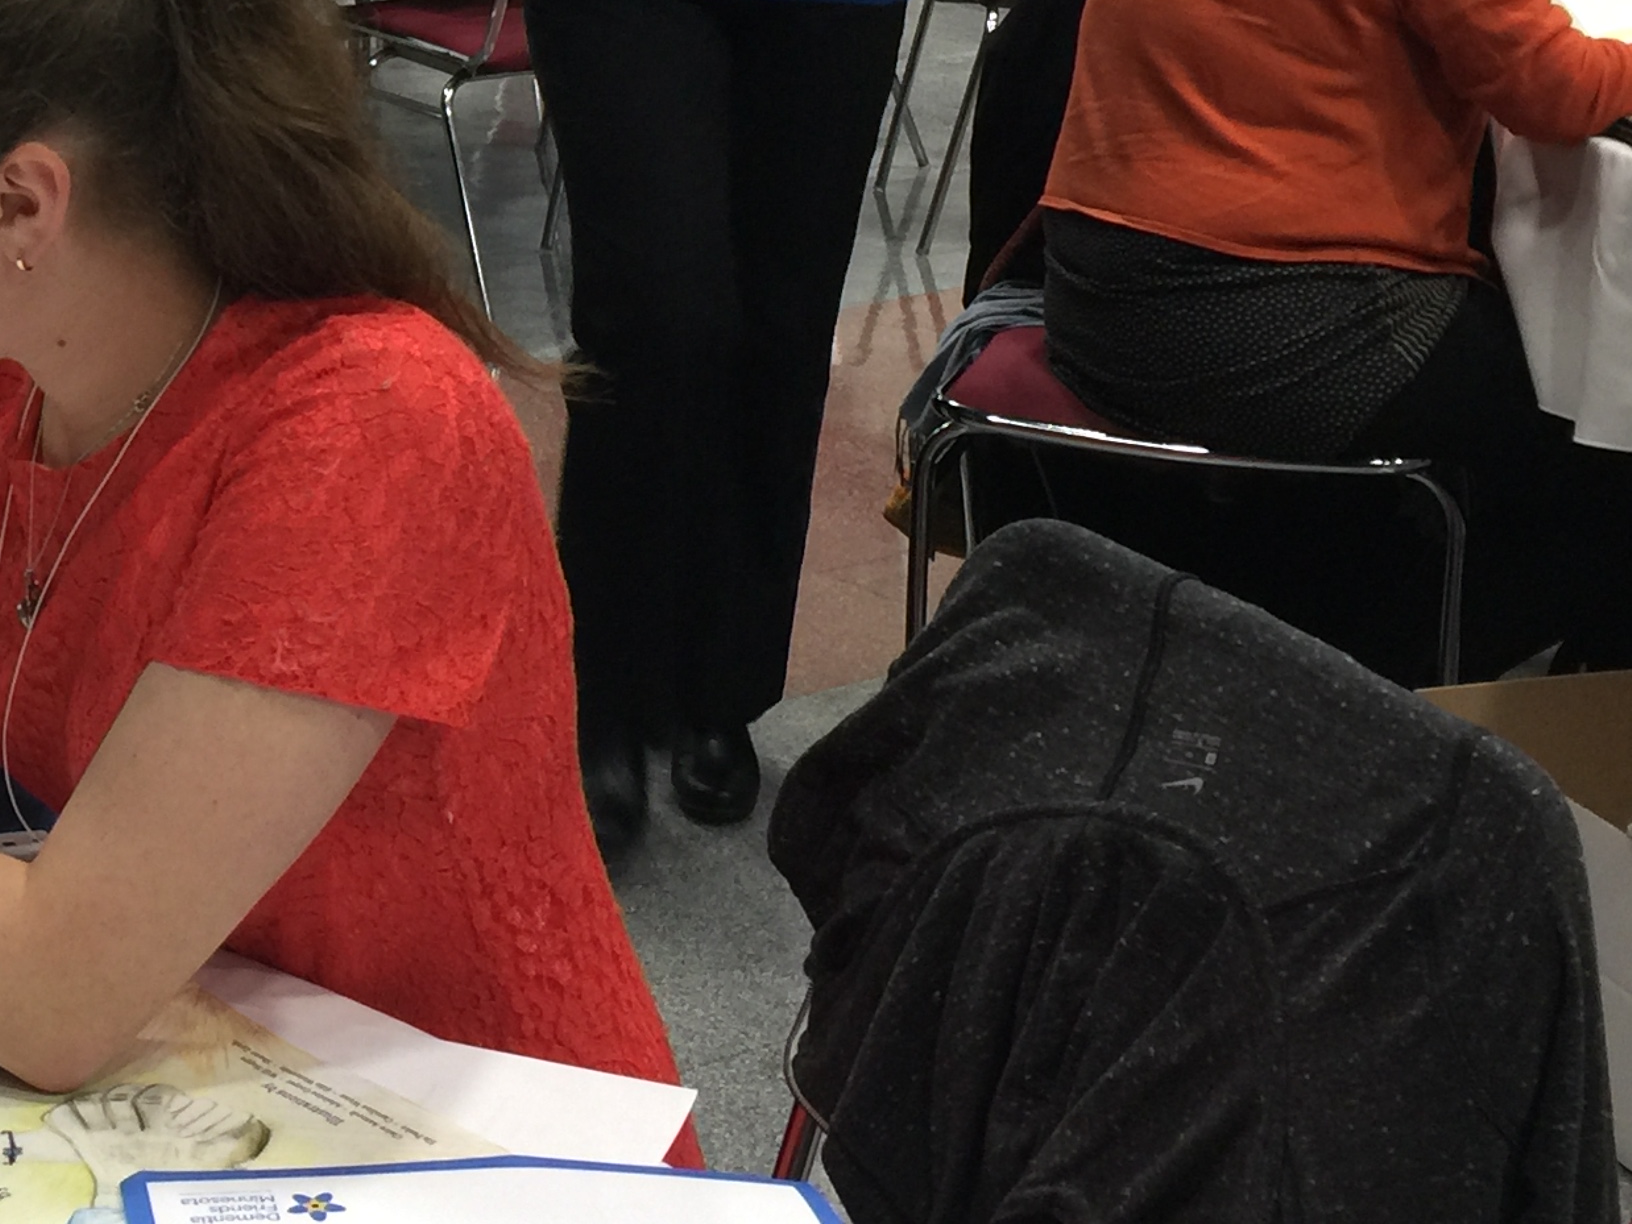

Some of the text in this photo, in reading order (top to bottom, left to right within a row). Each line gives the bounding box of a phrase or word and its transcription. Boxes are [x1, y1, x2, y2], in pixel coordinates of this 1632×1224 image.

[180, 1195, 275, 1206] Minnesota
[209, 1204, 278, 1213] Friends
[190, 1212, 281, 1224] Dementia
